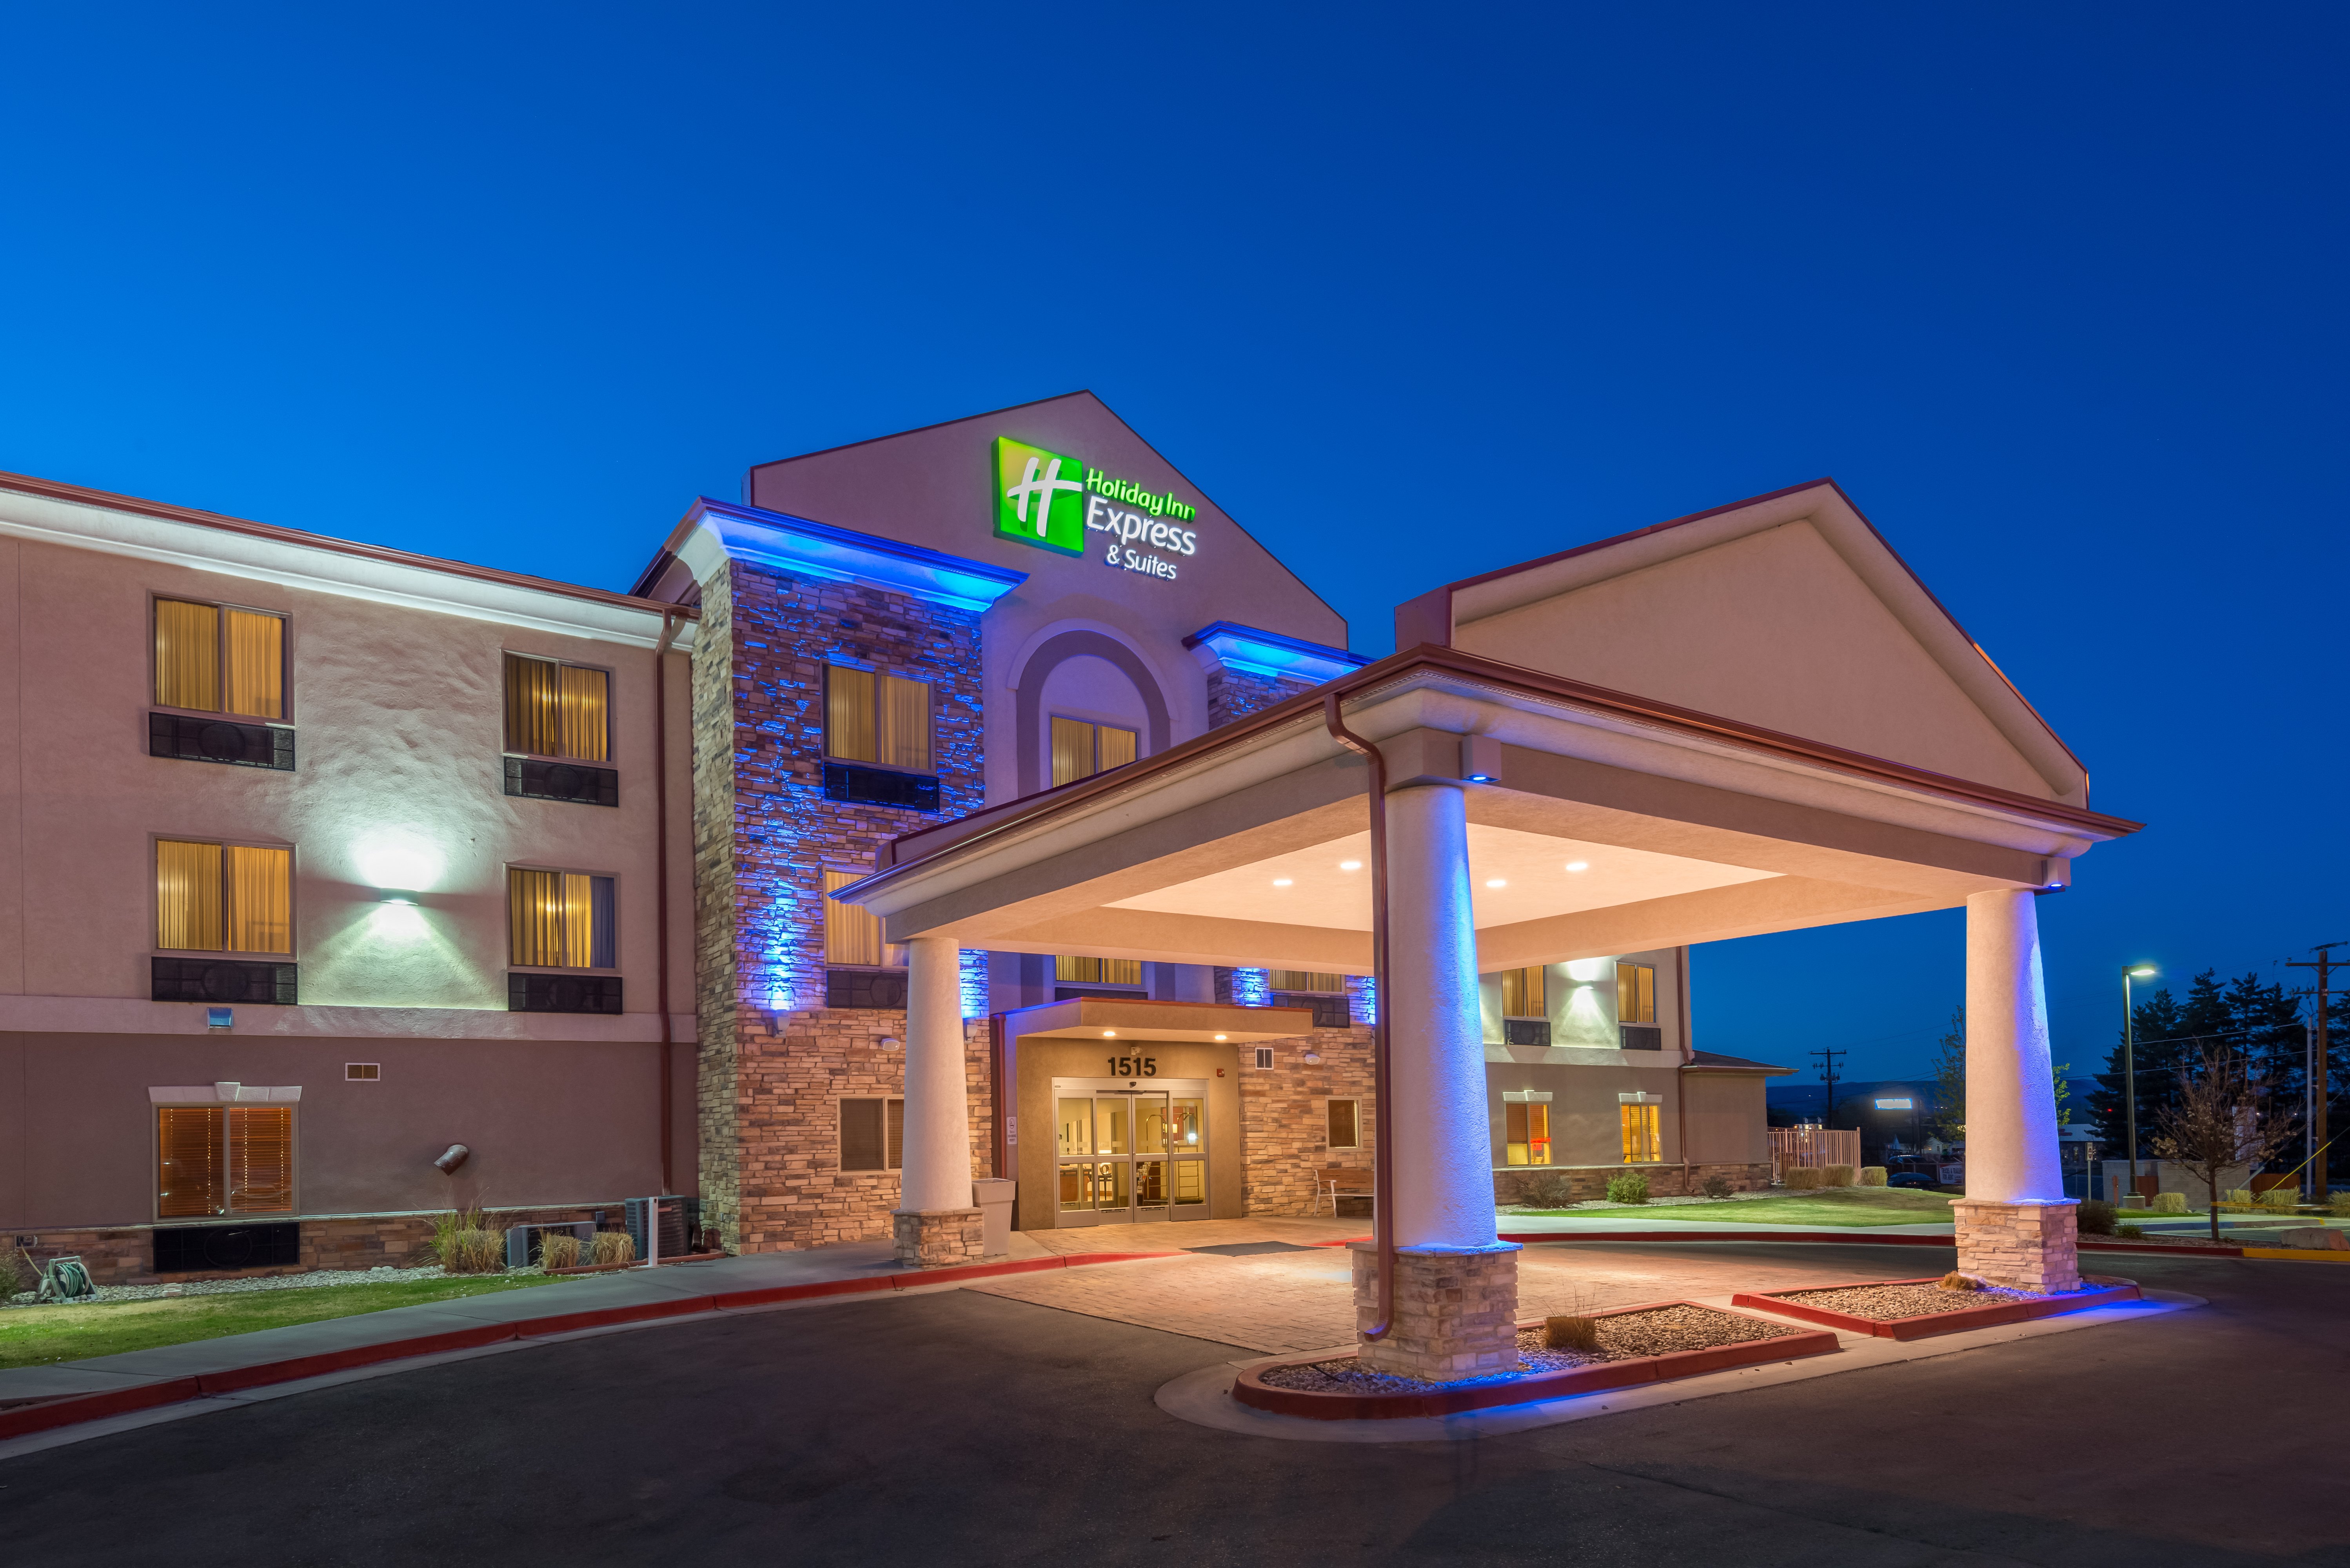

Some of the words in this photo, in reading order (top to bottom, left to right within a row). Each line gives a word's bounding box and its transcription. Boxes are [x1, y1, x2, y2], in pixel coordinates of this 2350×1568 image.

[1085, 468, 1164, 517] Holiday
[1166, 492, 1196, 522] Inn
[1086, 496, 1196, 555] Express
[1107, 545, 1120, 564] &
[1124, 550, 1177, 580] Suites
[1108, 1057, 1156, 1076] 1515
